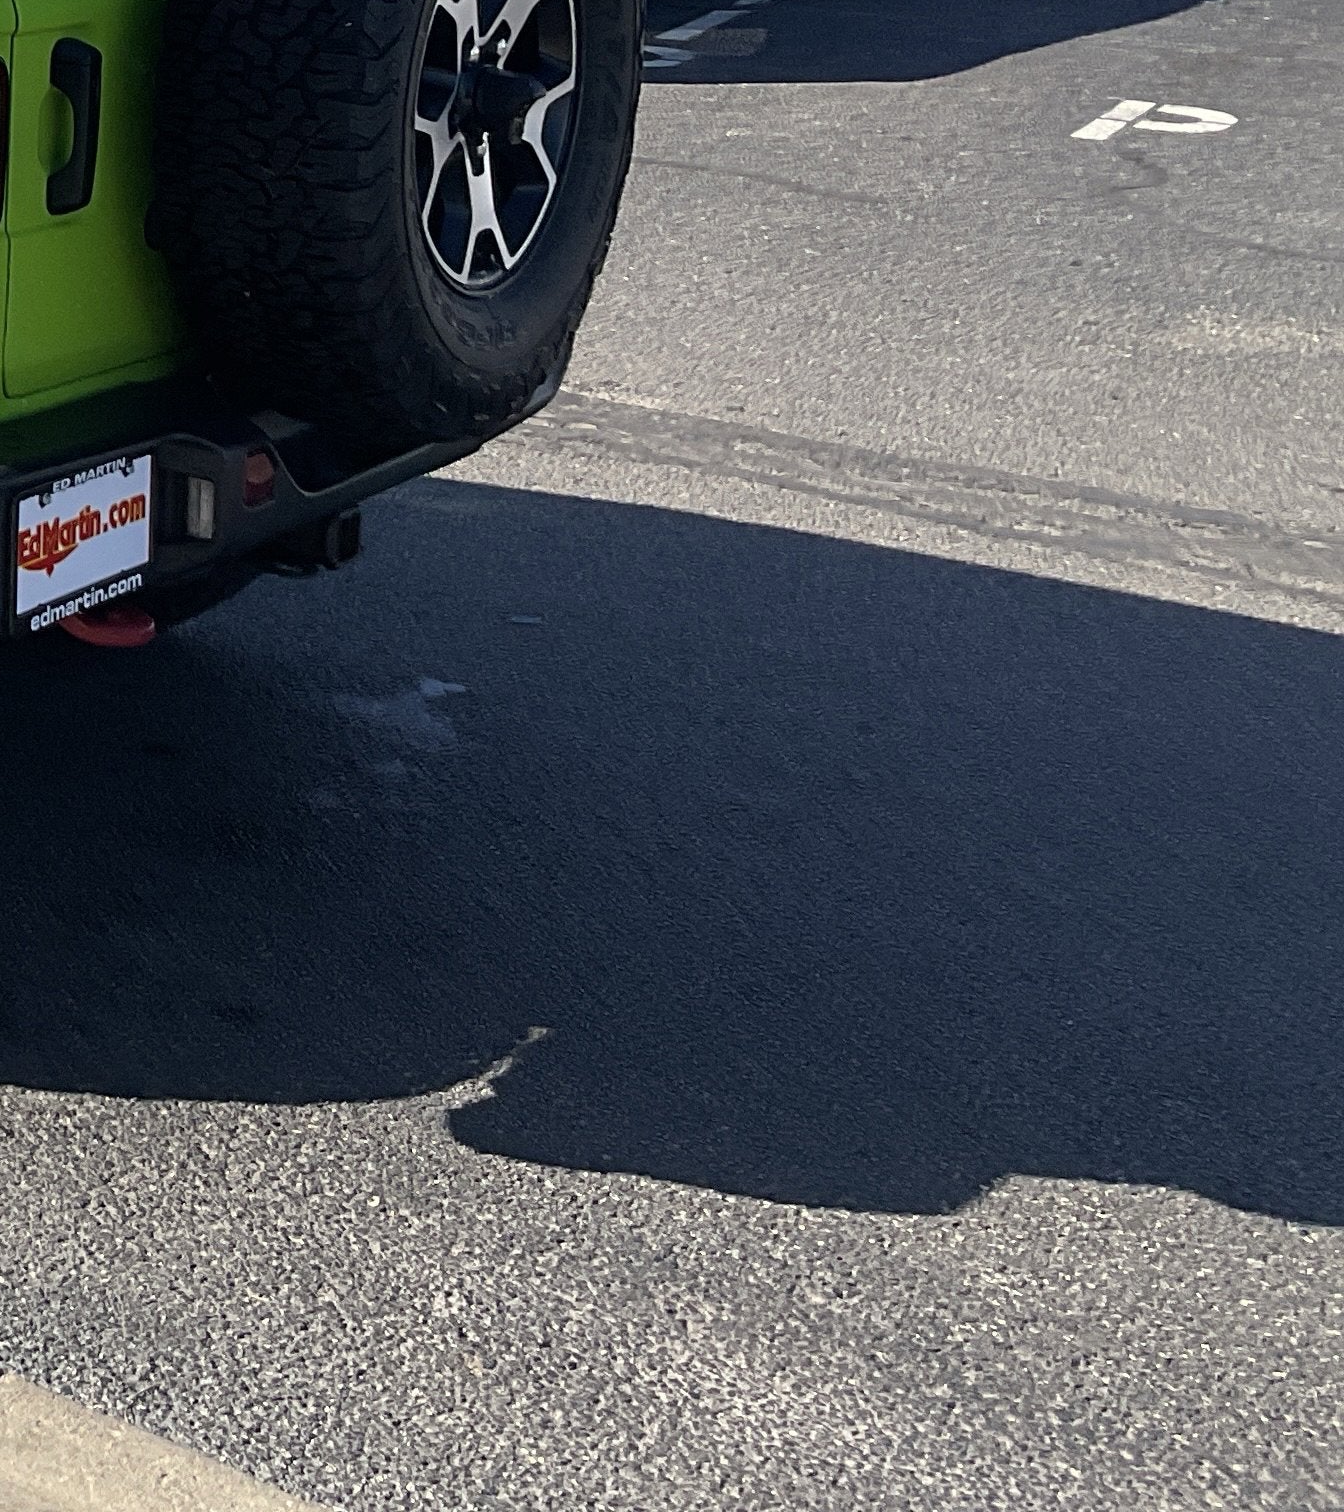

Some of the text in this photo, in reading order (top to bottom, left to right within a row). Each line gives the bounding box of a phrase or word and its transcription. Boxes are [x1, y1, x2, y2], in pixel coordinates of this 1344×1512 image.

[52, 456, 126, 493] ED MARTIN
[17, 493, 146, 563] EdMartin.com
[30, 573, 143, 631] edmartin.com
